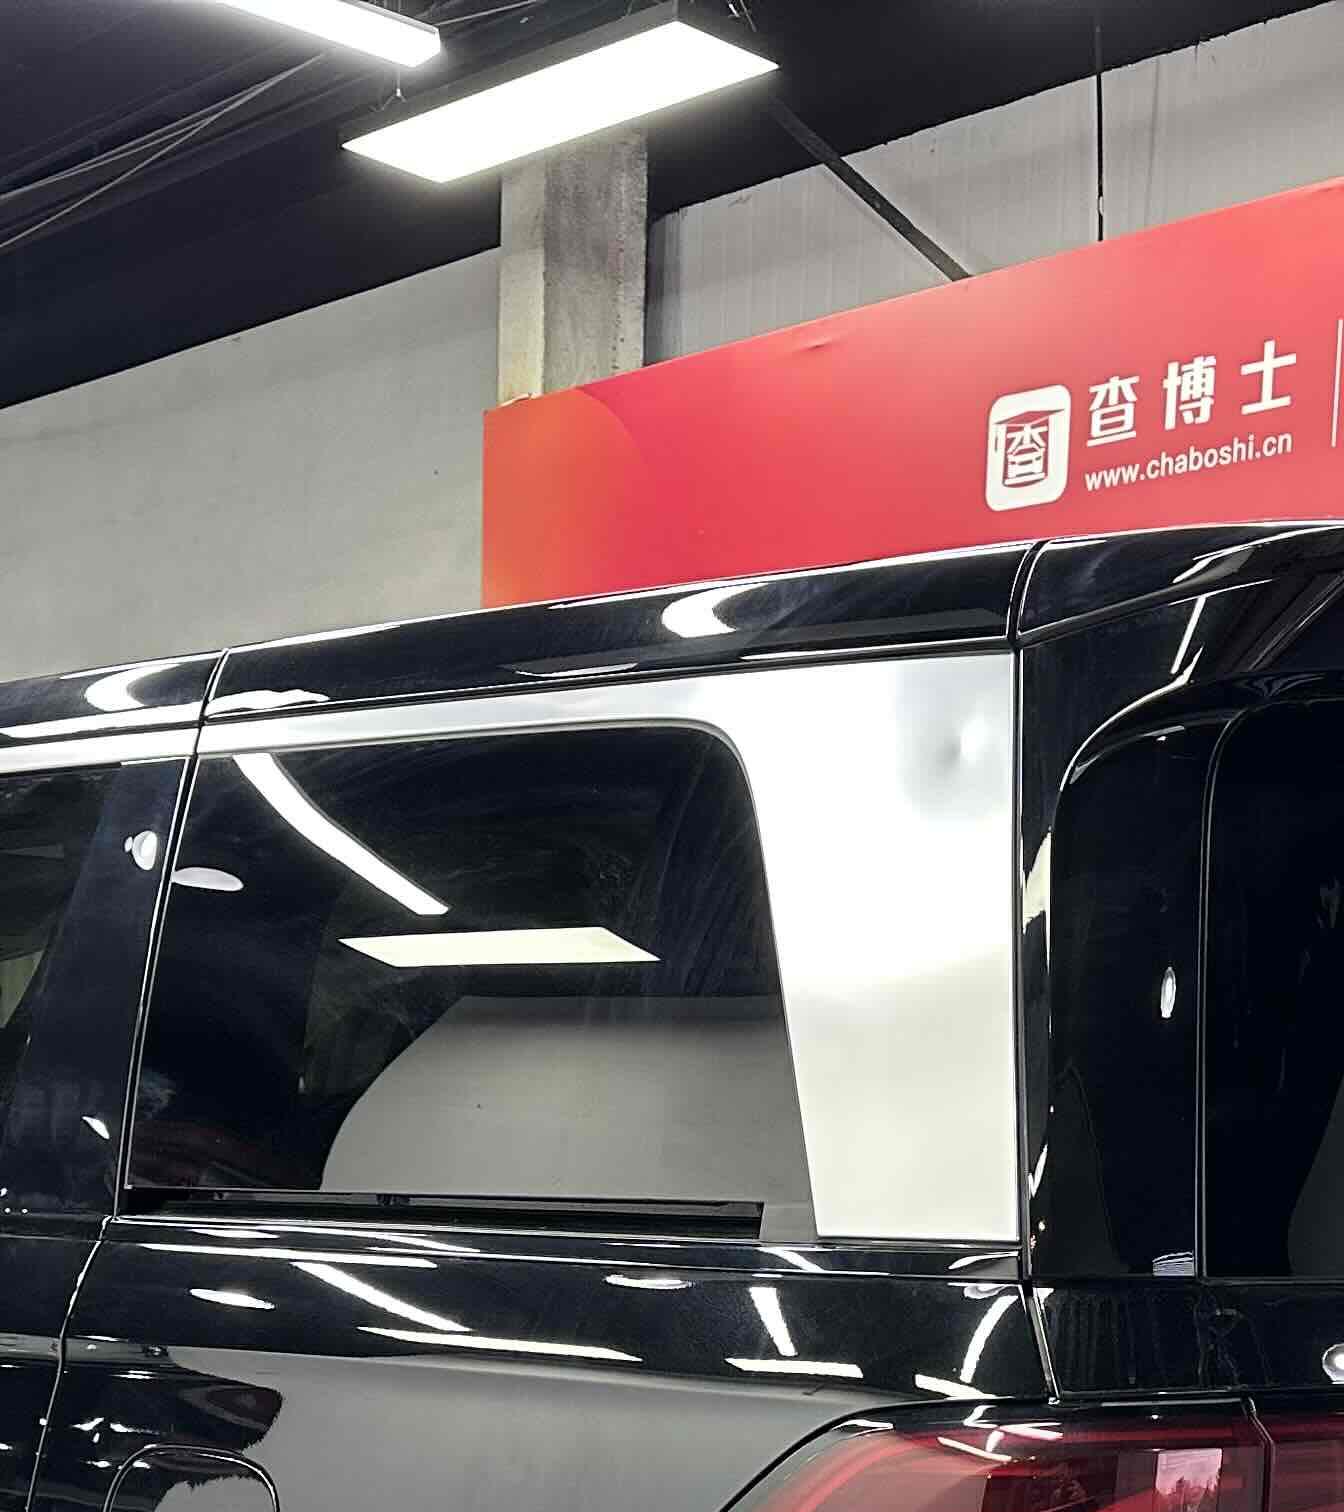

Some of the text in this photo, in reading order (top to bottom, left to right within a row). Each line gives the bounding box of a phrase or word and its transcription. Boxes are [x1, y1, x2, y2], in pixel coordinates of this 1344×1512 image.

[1086, 338, 1297, 448] 查博士
[1085, 431, 1294, 493] www.chaboshi.cn
